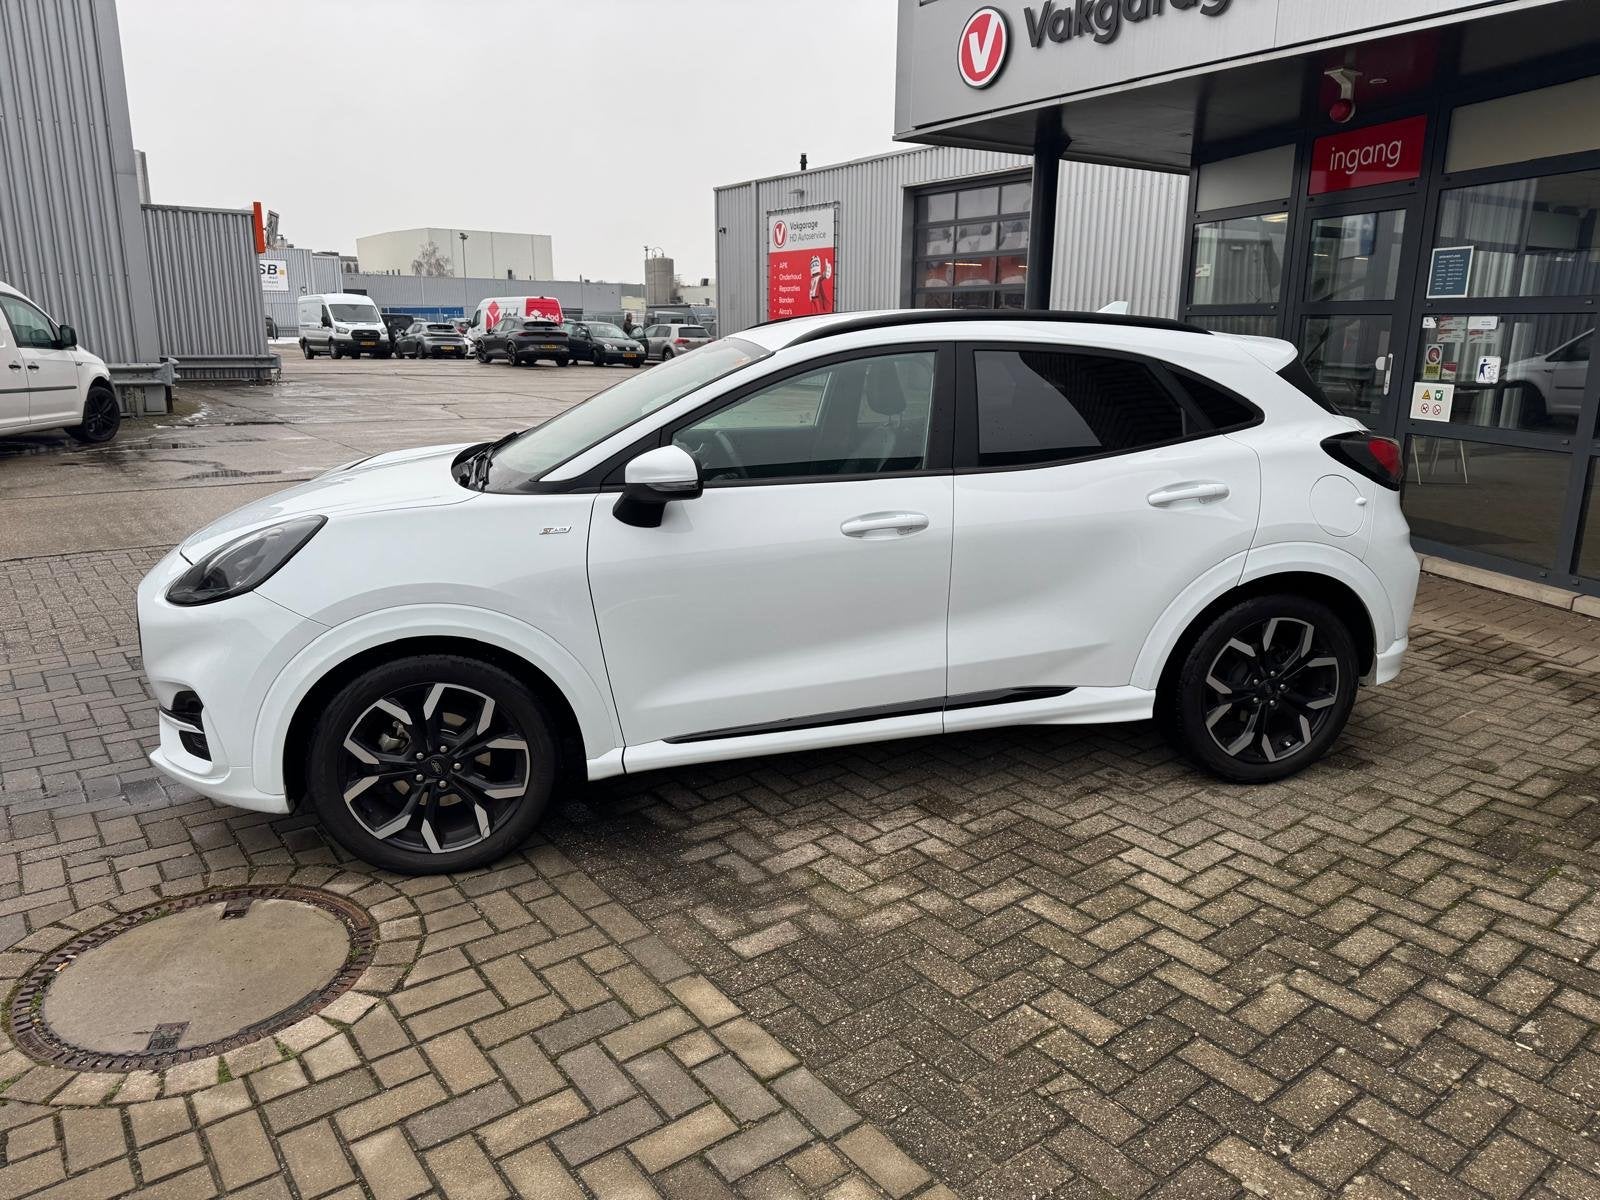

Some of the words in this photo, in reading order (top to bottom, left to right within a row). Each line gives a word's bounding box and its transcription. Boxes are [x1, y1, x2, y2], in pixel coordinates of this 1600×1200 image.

[1330, 140, 1401, 174] ingang
[790, 221, 818, 231] Vakgarage
[799, 231, 826, 241] Autoservice
[779, 273, 802, 281] Onderhoud
